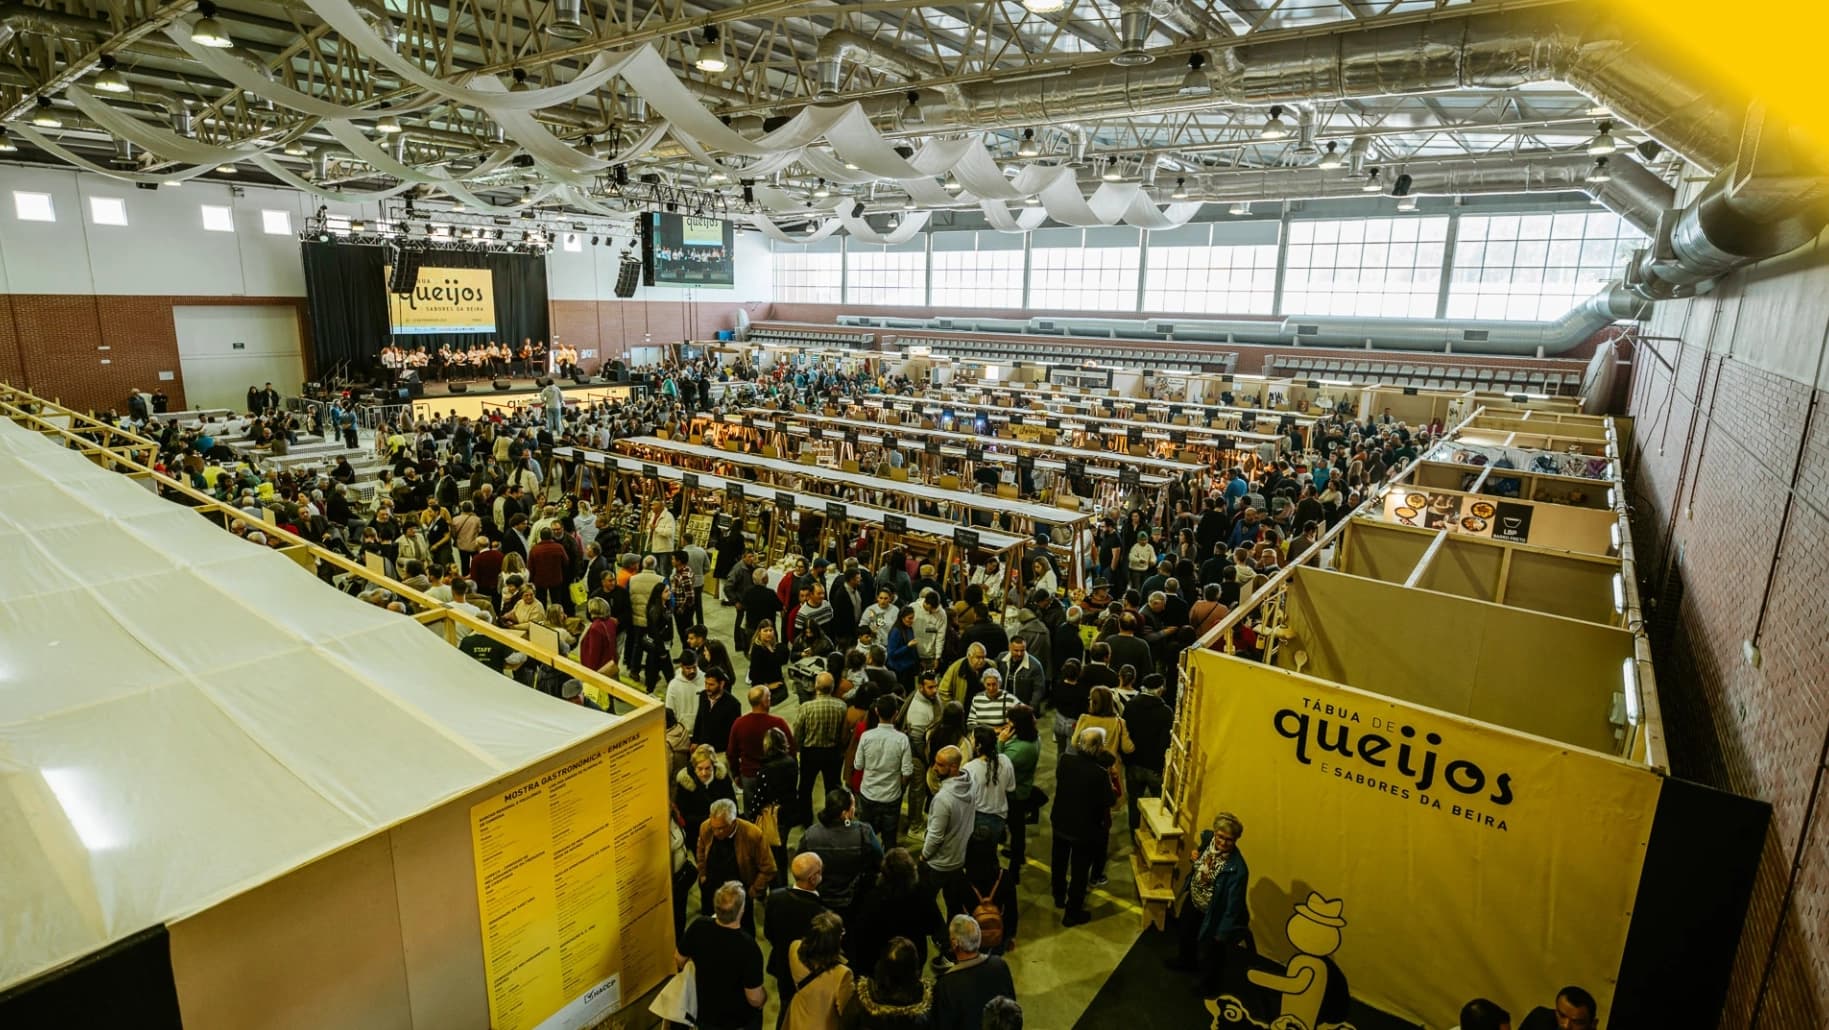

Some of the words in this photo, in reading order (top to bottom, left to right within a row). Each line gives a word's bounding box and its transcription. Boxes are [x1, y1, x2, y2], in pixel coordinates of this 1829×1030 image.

[400, 279, 482, 310] queijos
[1302, 697, 1360, 724] TÁBUA
[1371, 716, 1395, 733] DE
[503, 781, 540, 803] MOSTRA
[607, 733, 641, 753] EMENTAS
[1273, 708, 1513, 805] queijos
[1320, 762, 1329, 773] E
[1334, 767, 1410, 800] SABORES
[1419, 794, 1441, 810] DA
[1451, 805, 1508, 832] BEIRA
